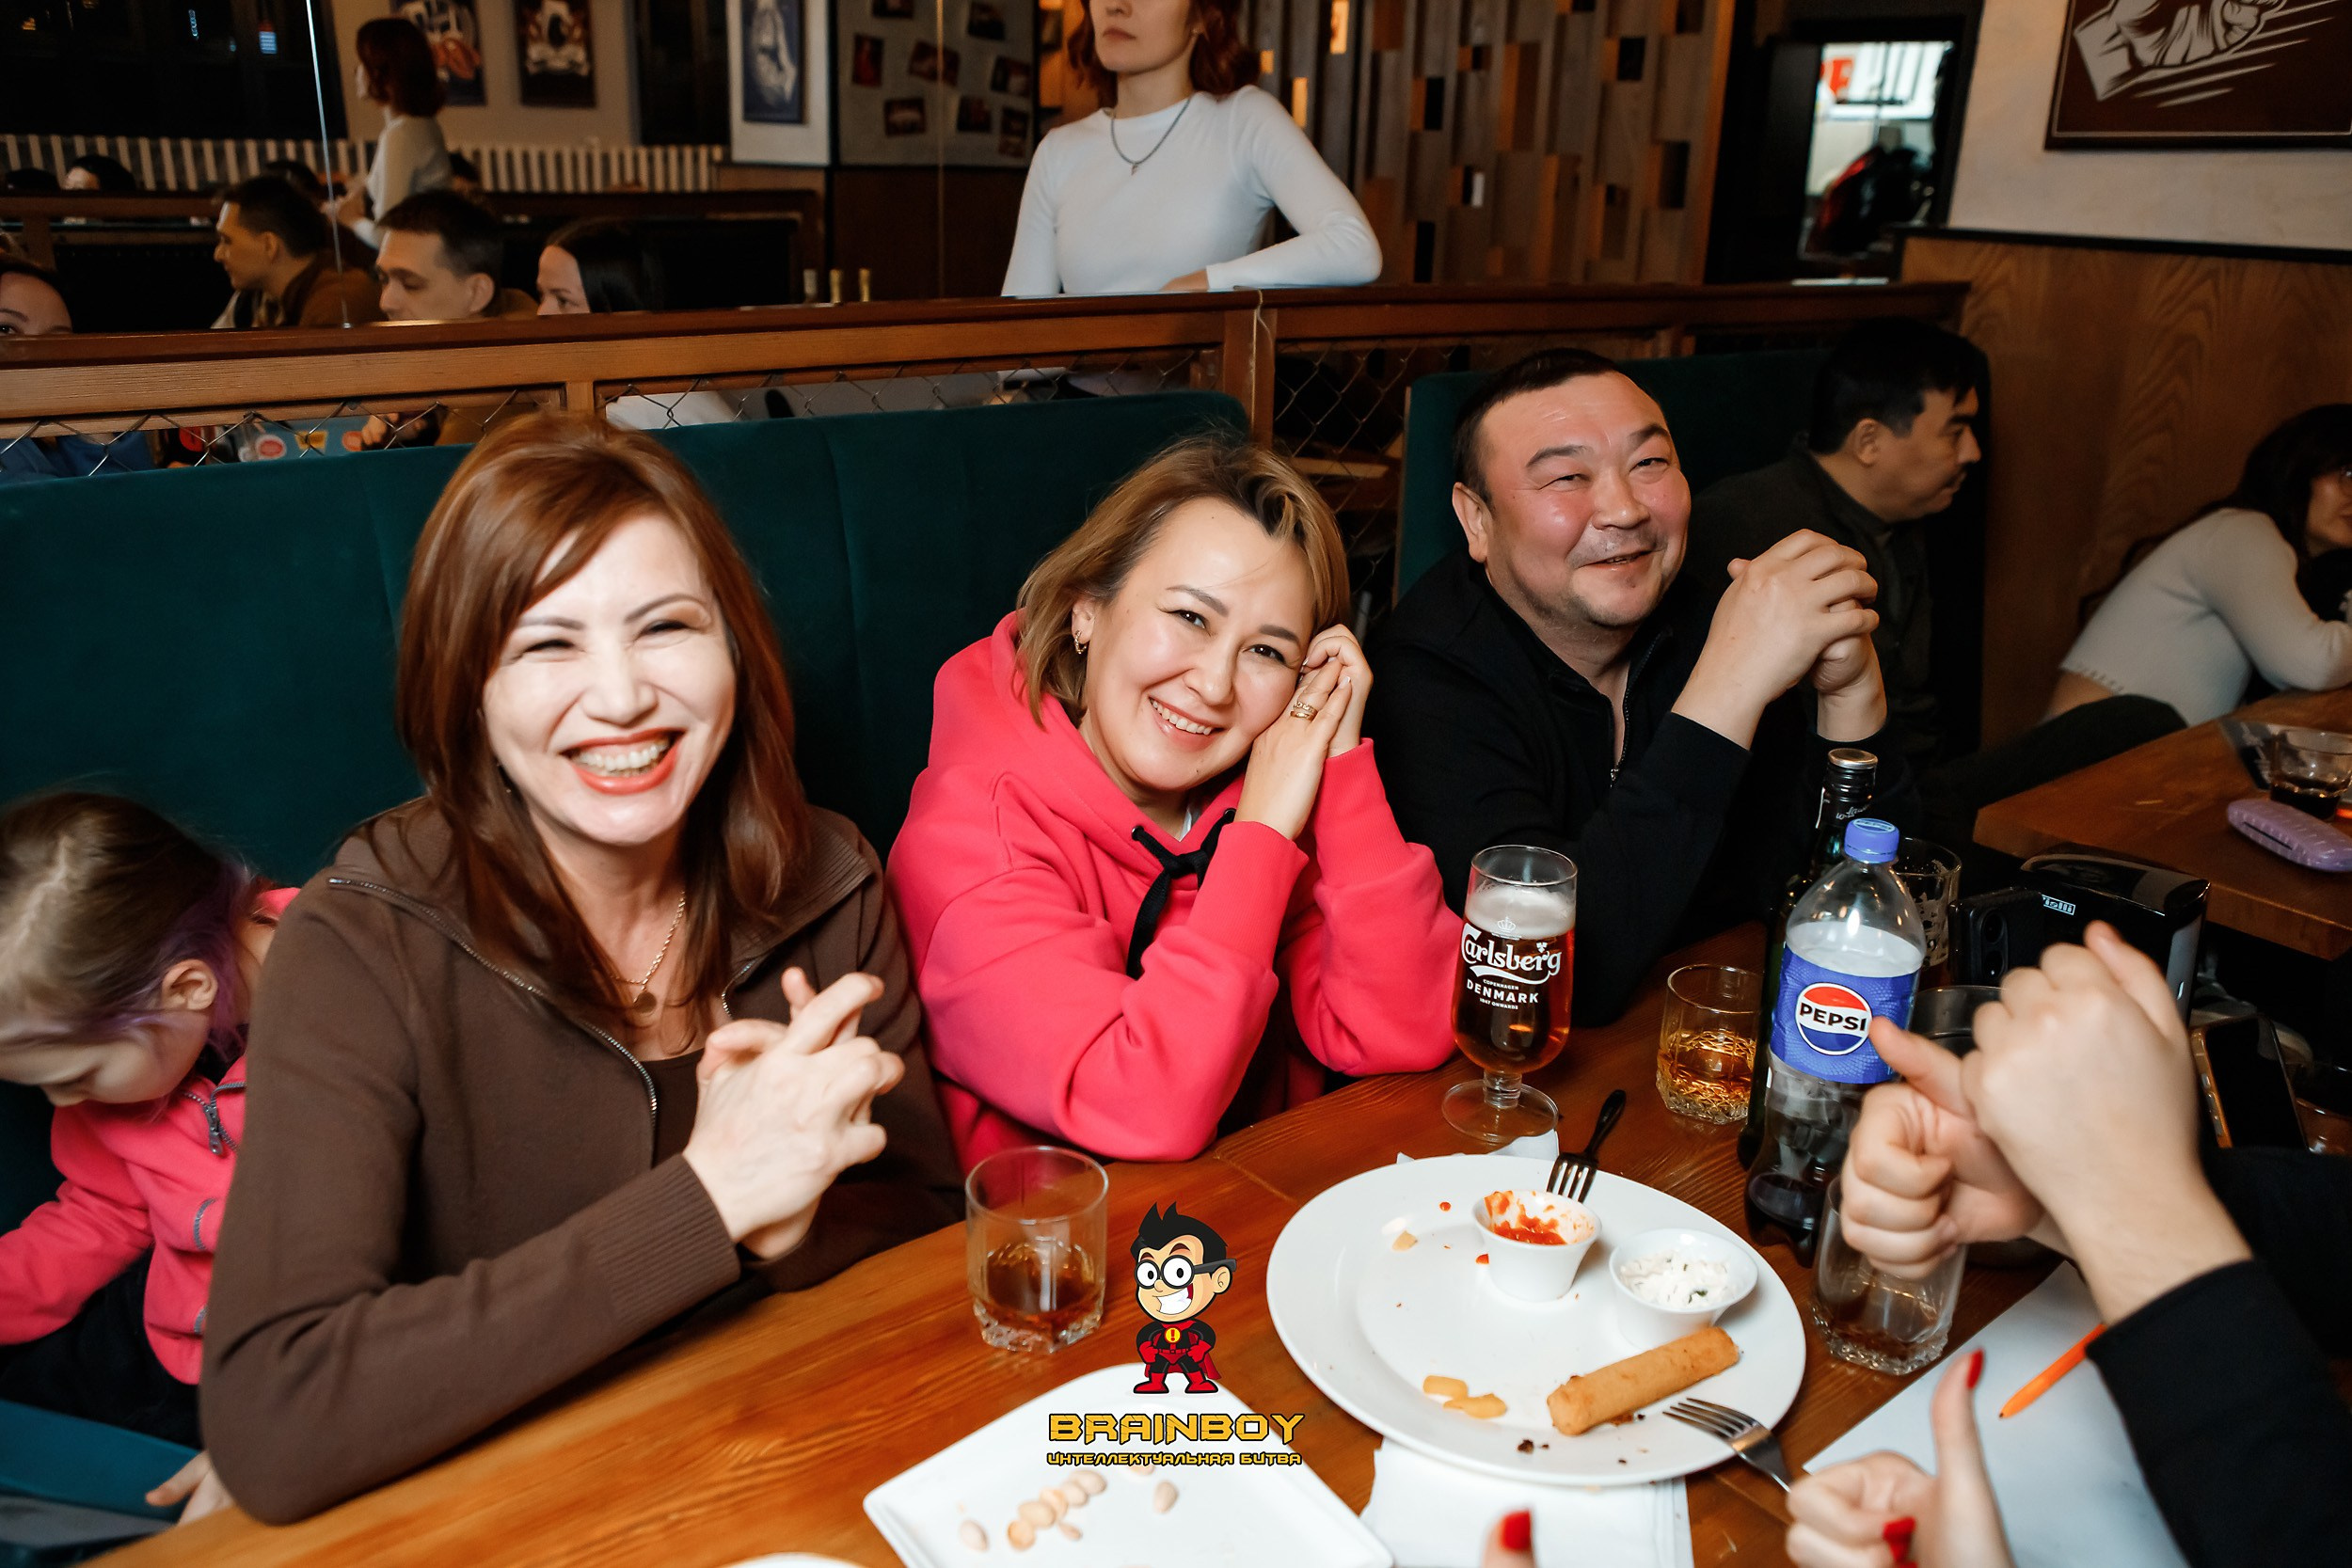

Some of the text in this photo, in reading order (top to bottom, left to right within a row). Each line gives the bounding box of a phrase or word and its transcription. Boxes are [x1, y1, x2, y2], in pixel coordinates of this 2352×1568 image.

[1461, 923, 1562, 976] Carlsberg
[1466, 978, 1539, 1004] DENMARK
[1799, 1002, 1867, 1032] PEPSI
